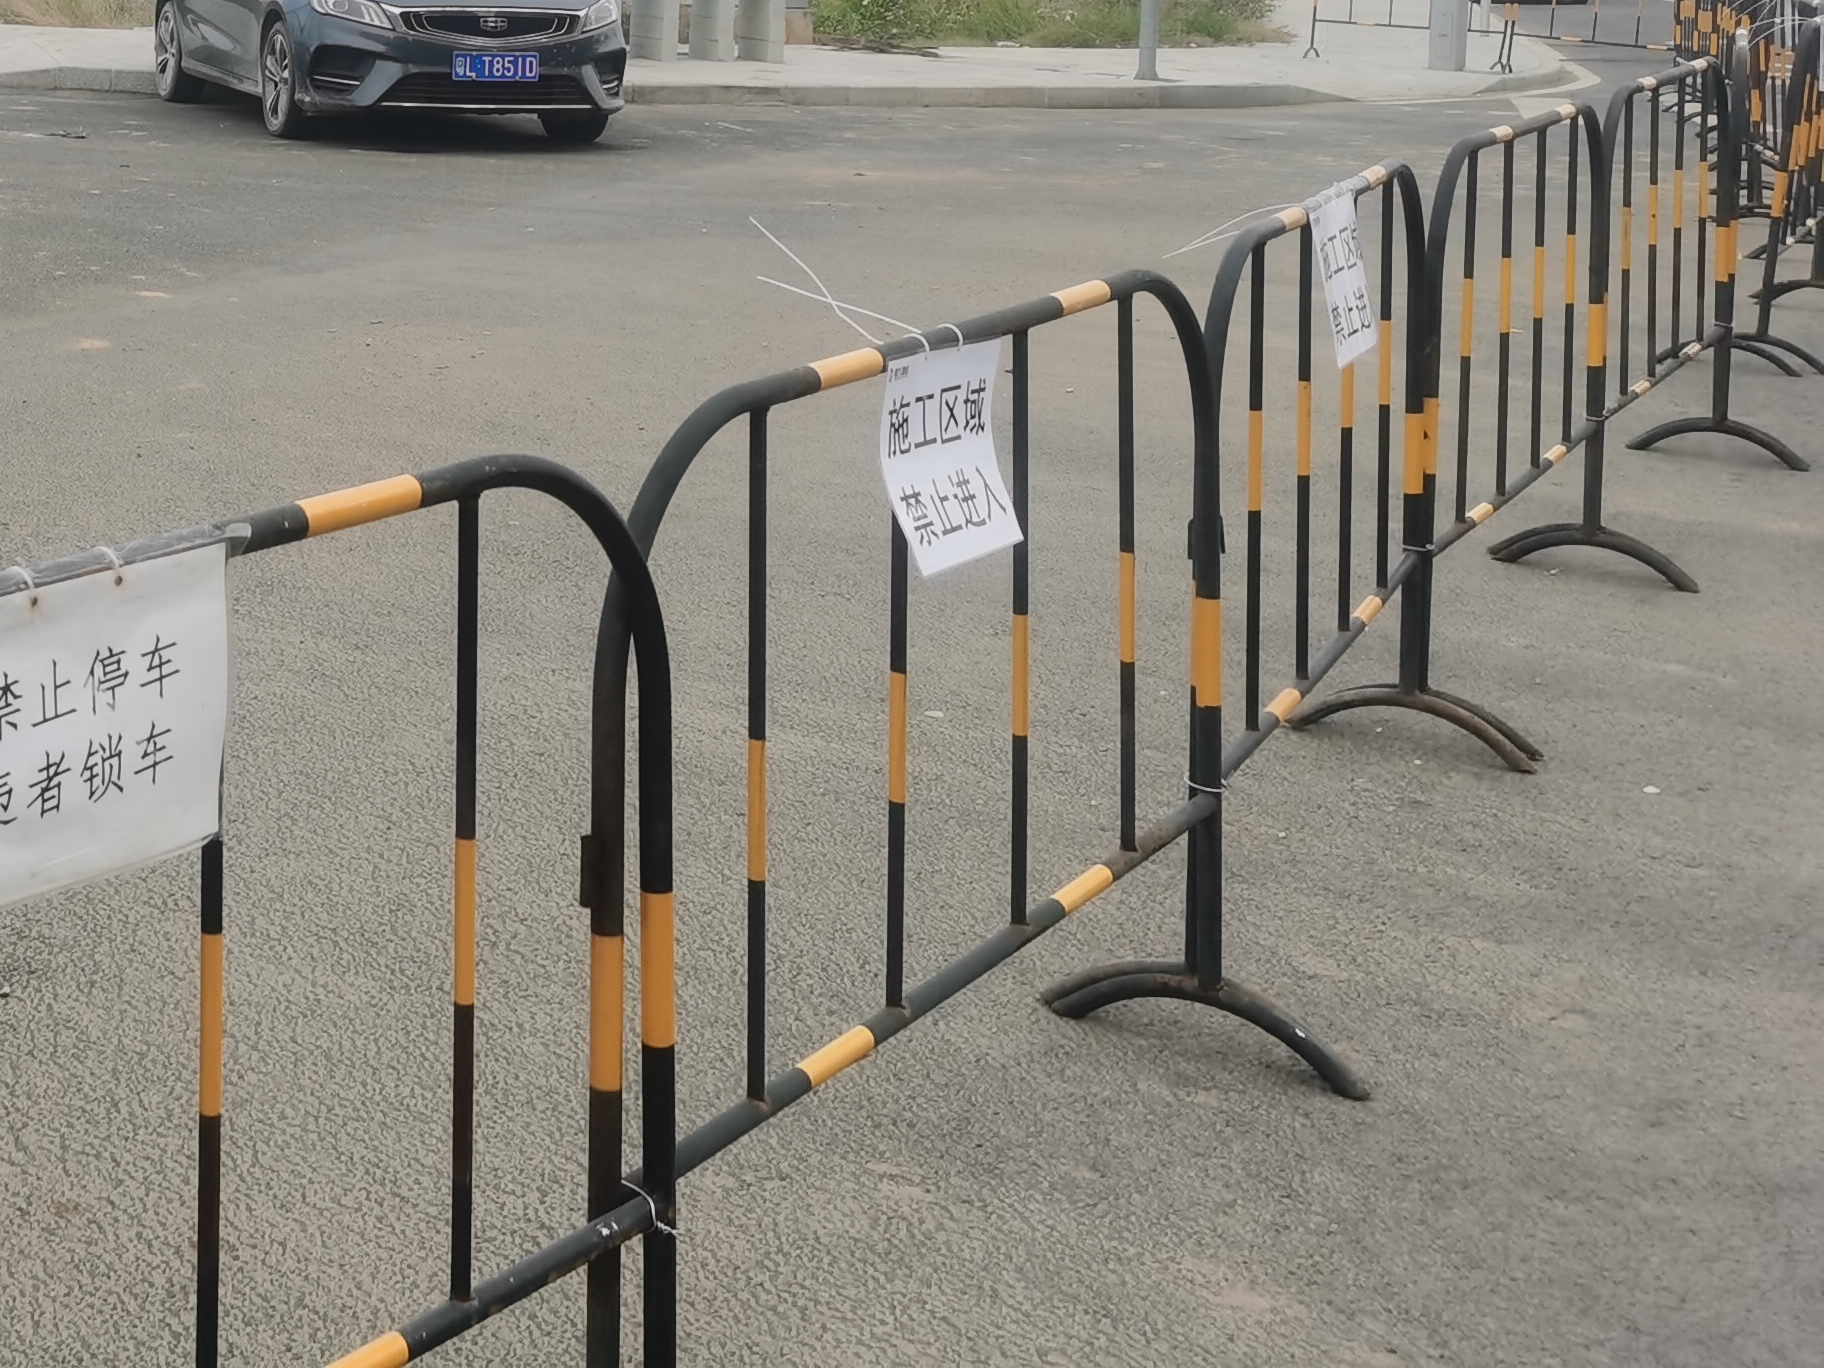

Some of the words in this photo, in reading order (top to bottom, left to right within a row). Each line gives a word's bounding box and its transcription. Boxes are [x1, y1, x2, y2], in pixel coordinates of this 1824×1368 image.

[887, 377, 987, 460] 施工区域
[899, 464, 1008, 547] 禁止进入
